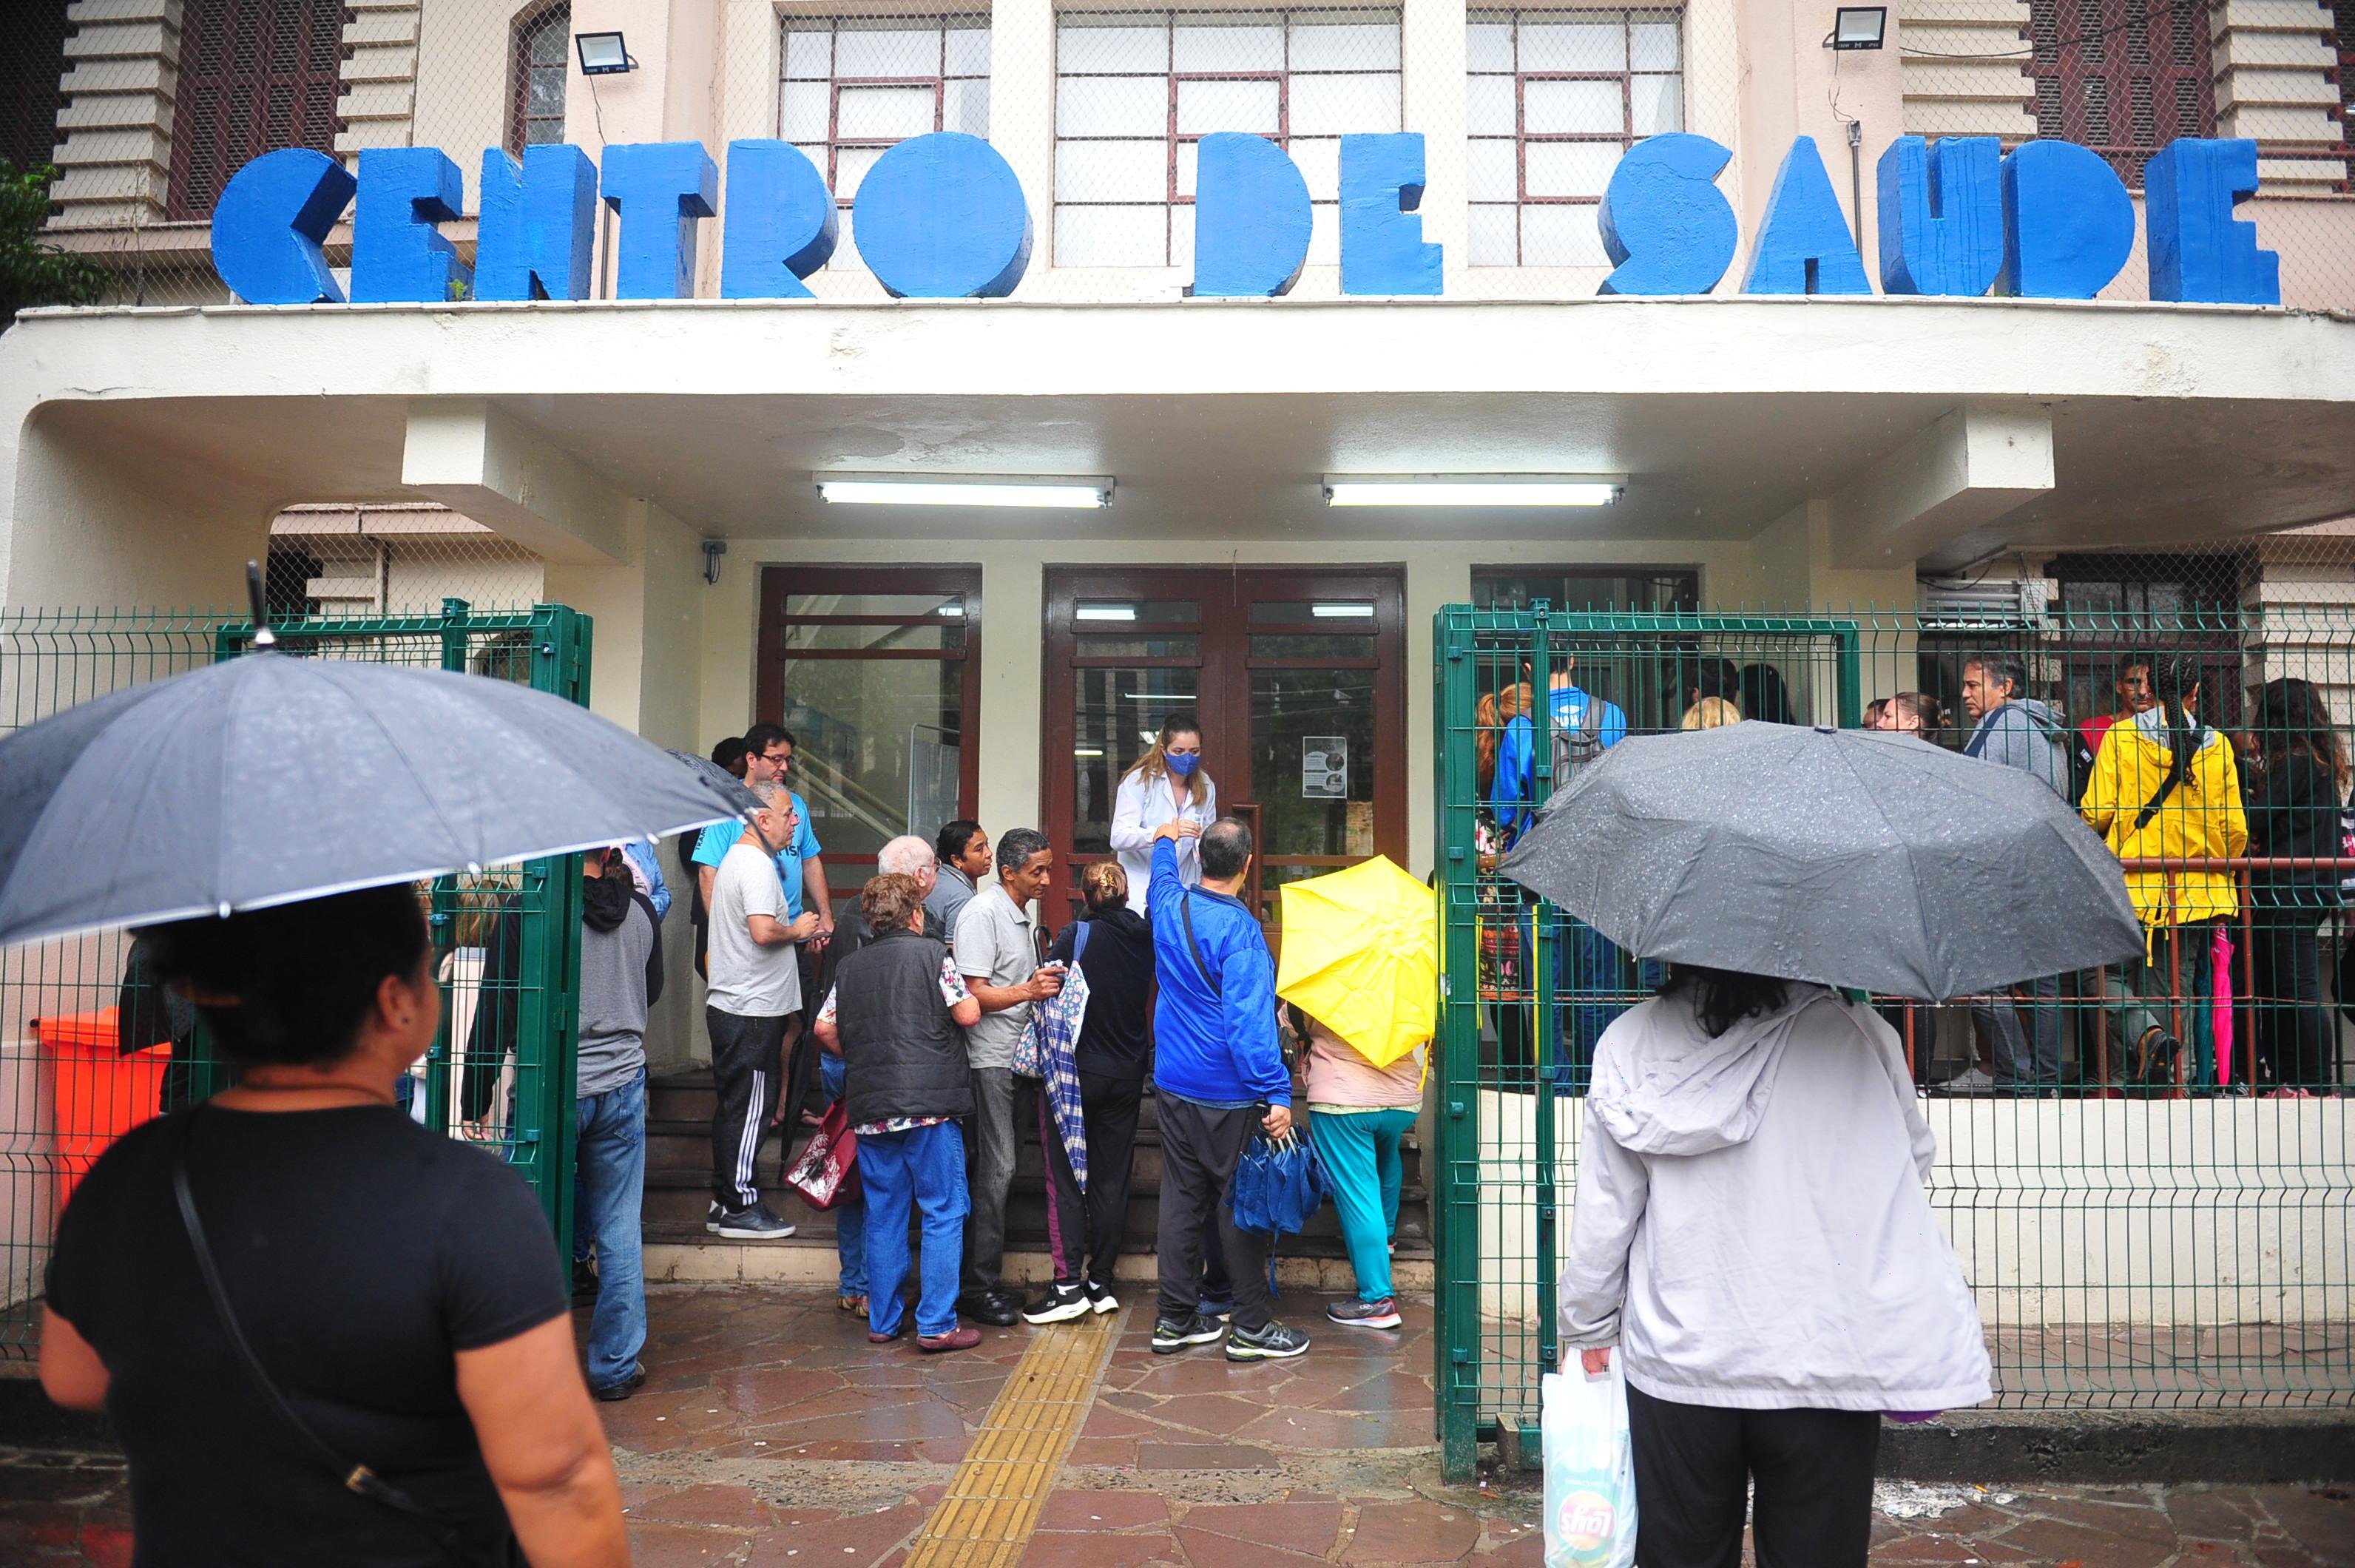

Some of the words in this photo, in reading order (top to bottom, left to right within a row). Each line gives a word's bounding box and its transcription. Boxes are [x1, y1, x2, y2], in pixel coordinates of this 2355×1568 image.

[212, 131, 1033, 305] CENTRO
[1194, 132, 1443, 296] DE
[1595, 132, 2280, 305] SAUDE
